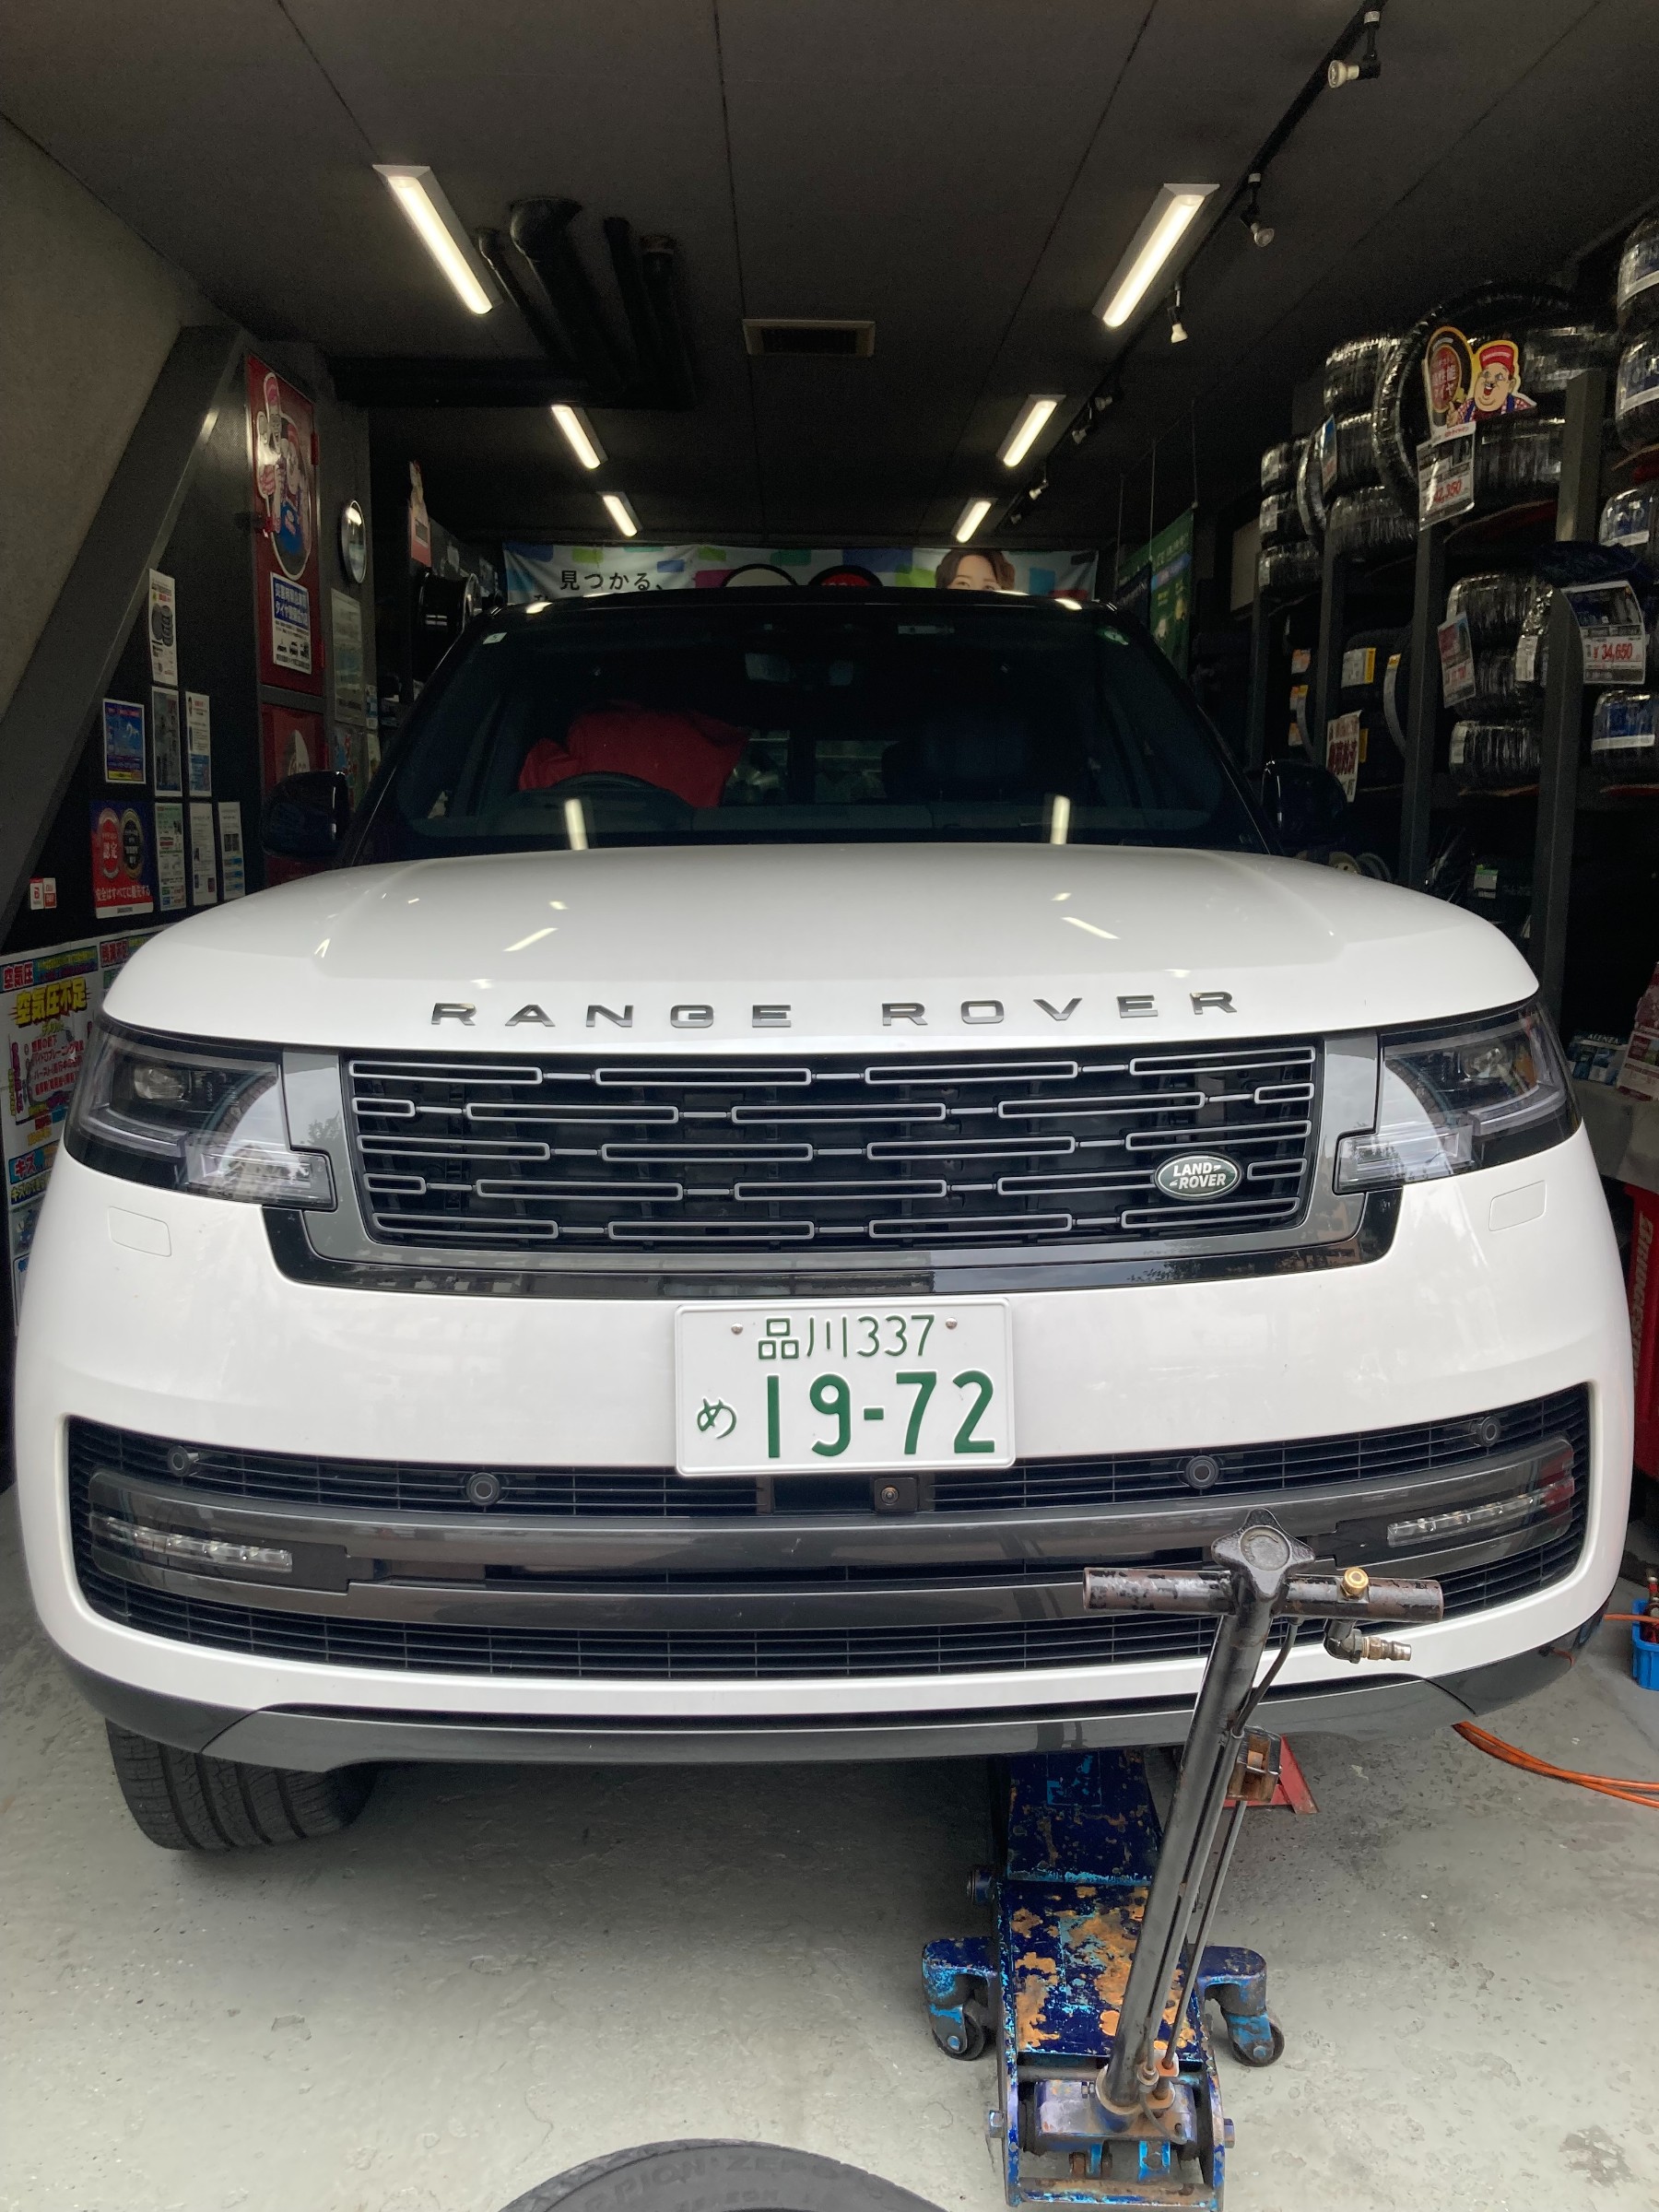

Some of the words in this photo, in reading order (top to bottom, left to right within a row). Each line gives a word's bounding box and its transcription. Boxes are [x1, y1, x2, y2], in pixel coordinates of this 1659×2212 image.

[559, 568, 663, 591] 見つかる、
[3, 961, 34, 990] 空気圧
[15, 977, 88, 1028] 空気圧不足
[431, 1002, 792, 1028] RANGE
[882, 991, 1237, 1026] ROVER
[1172, 1162, 1213, 1177] LAND
[1178, 1173, 1227, 1190] ROVER
[696, 1396, 738, 1440] め
[765, 1369, 996, 1459] 19-72
